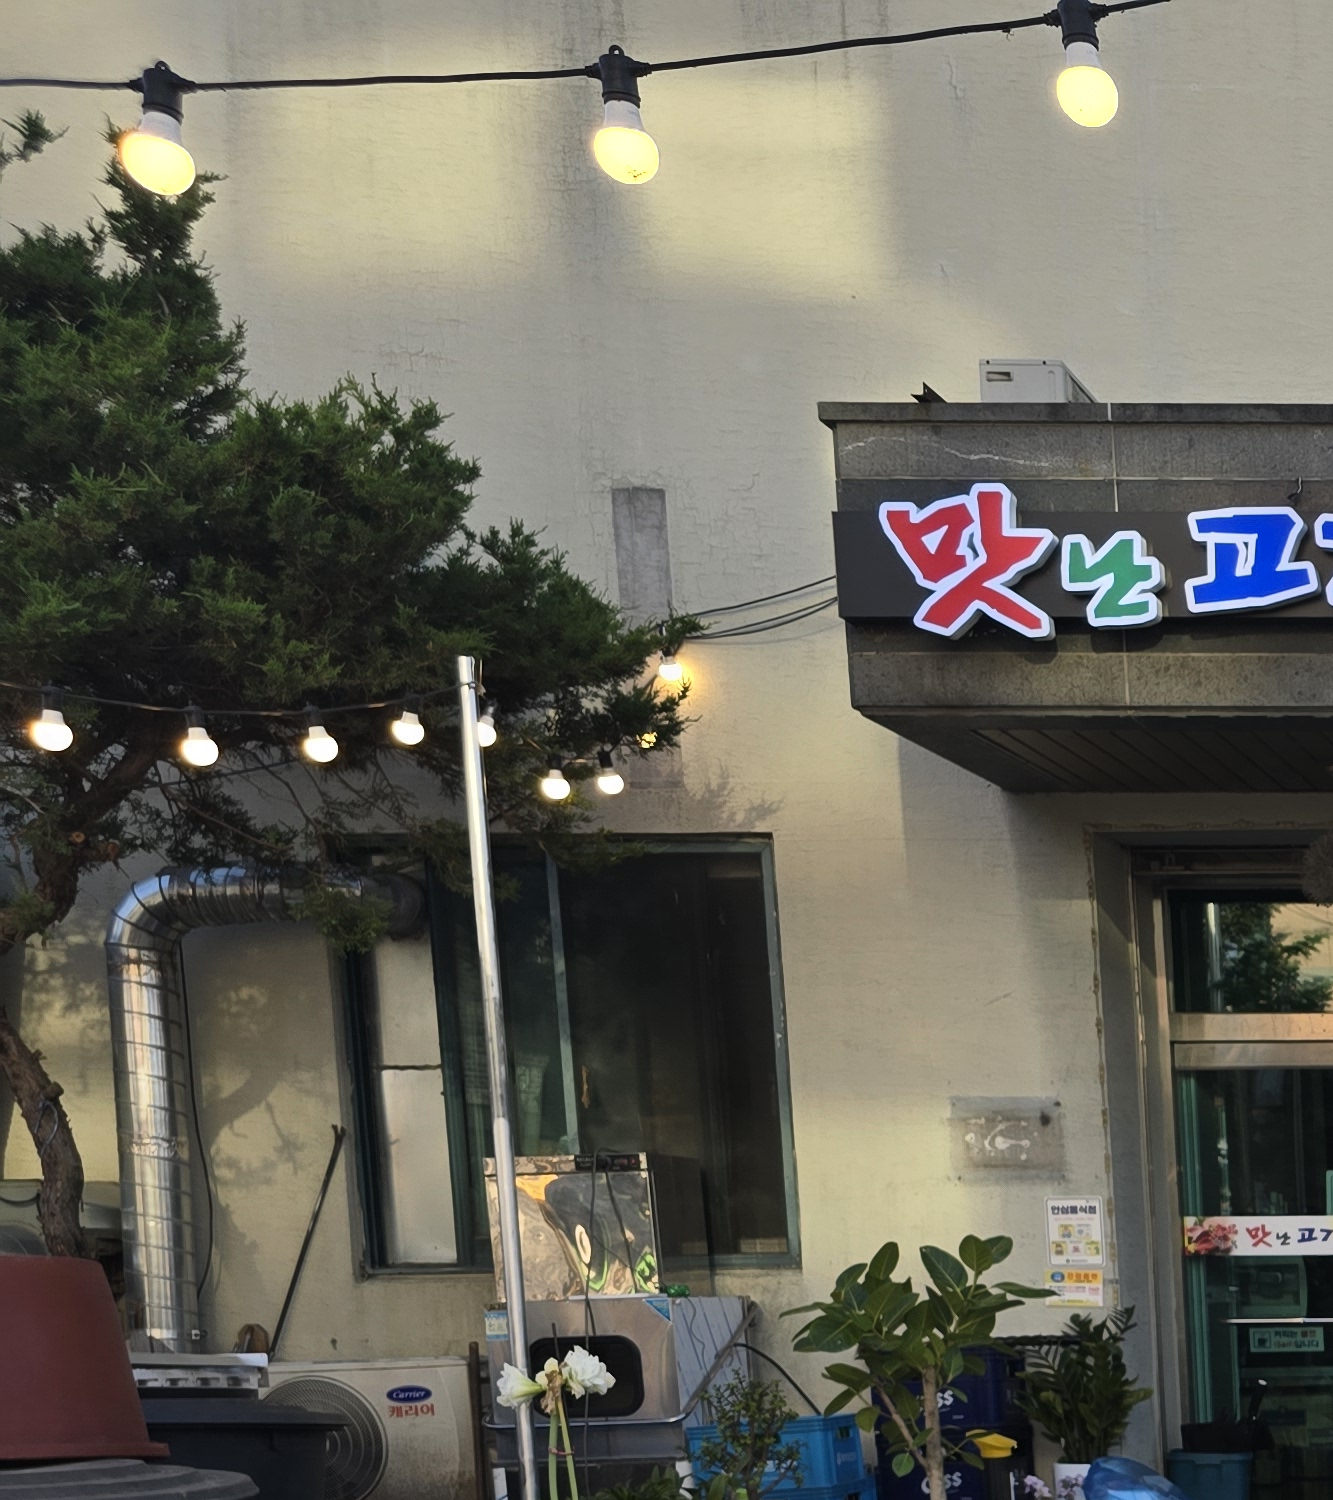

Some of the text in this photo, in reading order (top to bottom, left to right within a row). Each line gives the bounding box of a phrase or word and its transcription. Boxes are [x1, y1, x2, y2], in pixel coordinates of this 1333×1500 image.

[392, 1389, 426, 1399] Carrier
[388, 1403, 436, 1419] 캐리어
[920, 1471, 963, 1495] Css
